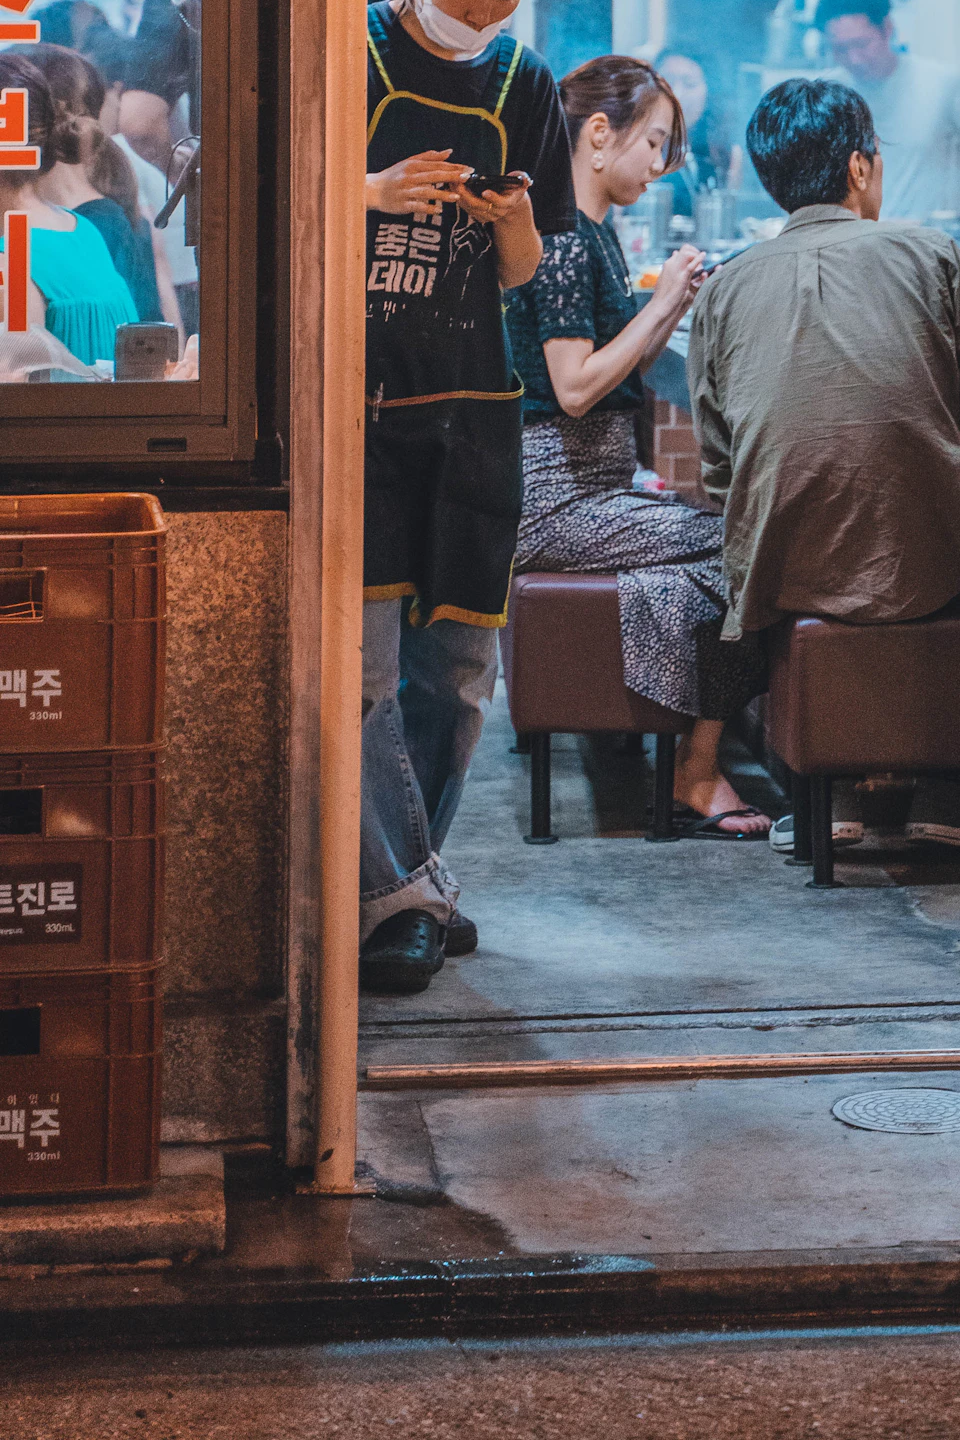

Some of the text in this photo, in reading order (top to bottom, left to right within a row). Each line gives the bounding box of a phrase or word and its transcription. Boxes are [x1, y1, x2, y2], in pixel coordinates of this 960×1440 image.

[366, 260, 437, 297] 데이
[0, 669, 62, 708] 맥주
[29, 711, 63, 720] 330ml
[0, 1108, 61, 1149] 맥주
